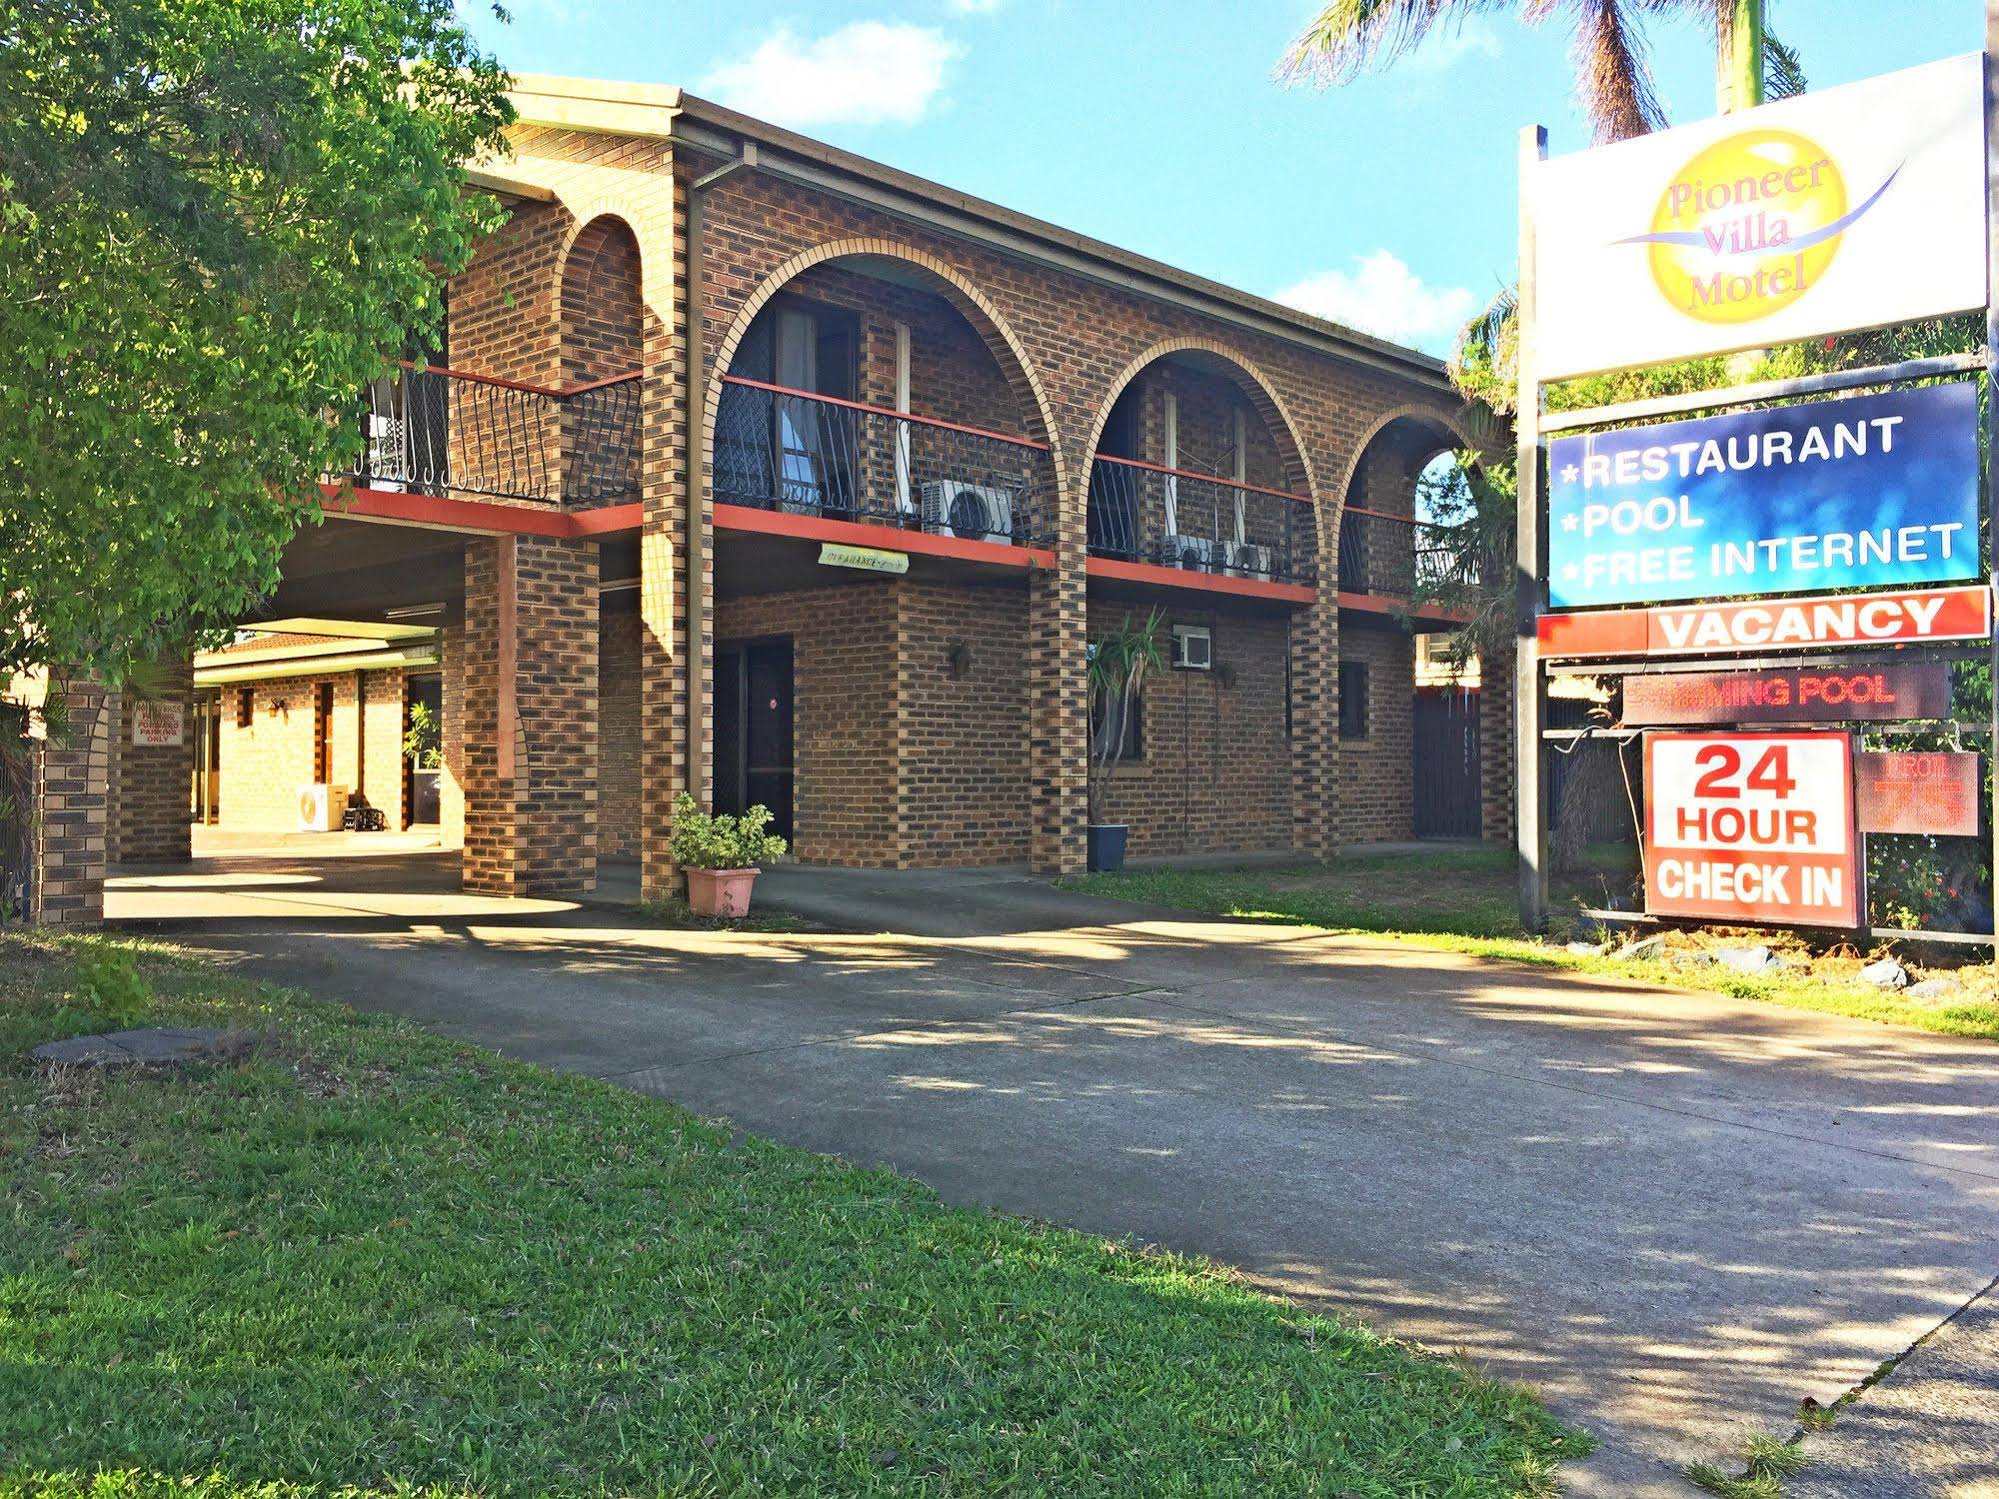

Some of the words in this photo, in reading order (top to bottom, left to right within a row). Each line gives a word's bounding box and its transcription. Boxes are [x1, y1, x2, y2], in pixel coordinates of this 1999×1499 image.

[1668, 157, 1831, 219] Pioneer
[1701, 211, 1793, 256] Villa
[1688, 254, 1808, 310] Motel
[1583, 416, 1904, 488] RESTAURANT
[1583, 494, 1705, 538] POOL
[1583, 546, 1695, 588] FREE
[1711, 522, 1964, 577] INTERNET
[1659, 597, 1946, 648] VACANCY
[1799, 675, 1896, 706] POOL
[1693, 744, 1797, 800] 24
[1676, 807, 1817, 846] HOUR
[1657, 859, 1789, 905] CHECK
[1801, 865, 1843, 908] IN
